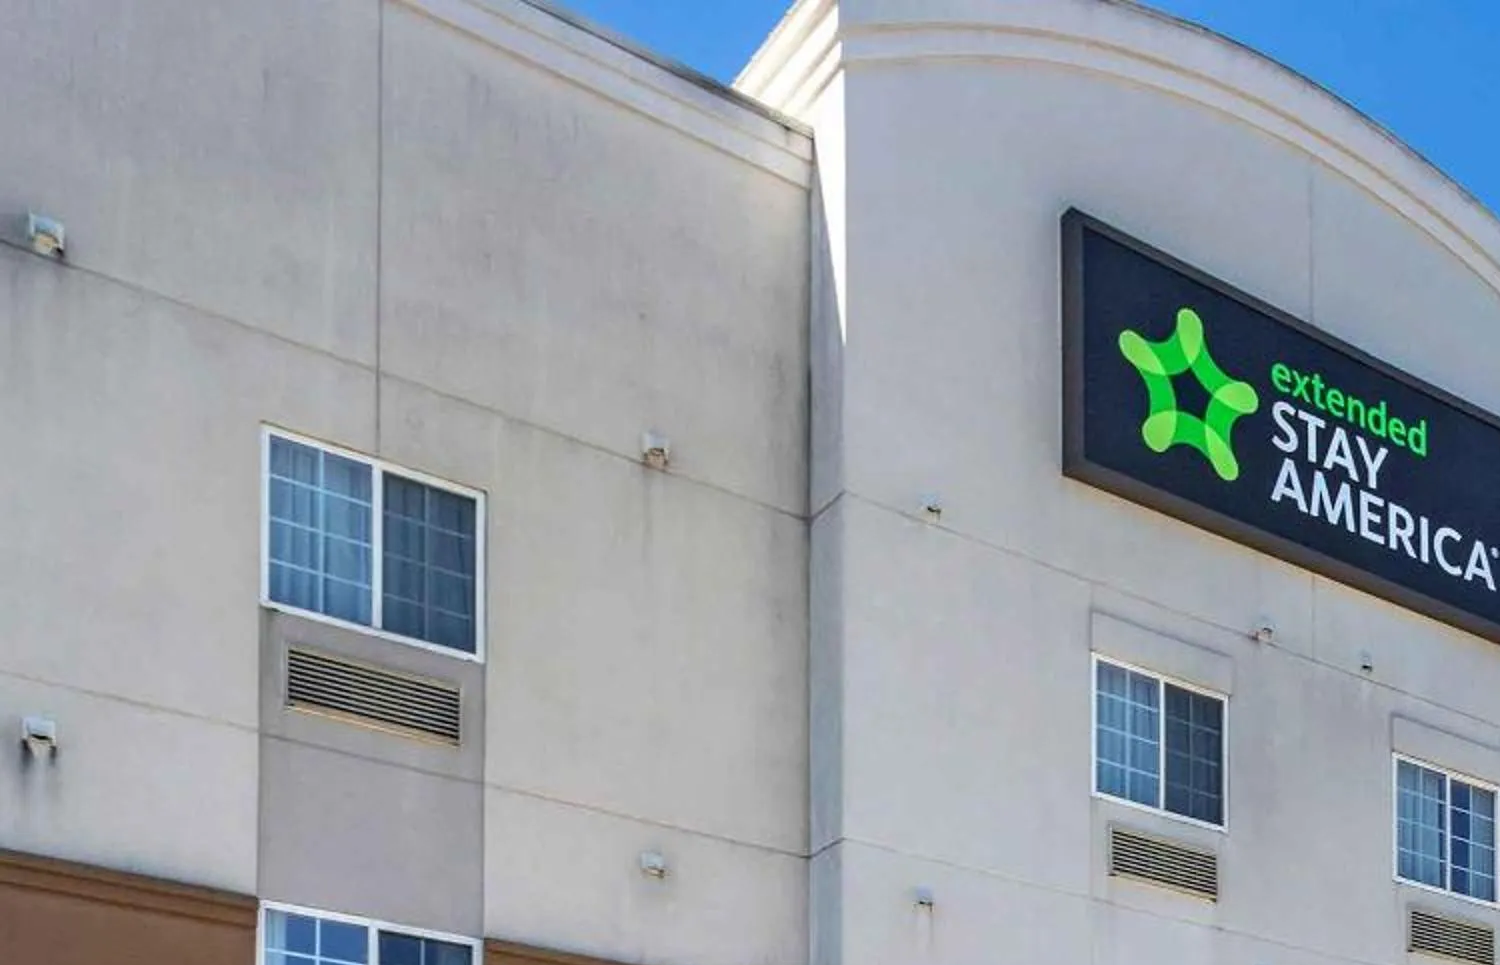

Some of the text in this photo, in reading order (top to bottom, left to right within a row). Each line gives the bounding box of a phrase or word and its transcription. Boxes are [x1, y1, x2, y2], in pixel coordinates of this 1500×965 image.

[1271, 363, 1428, 457] extended
[1271, 401, 1389, 489] STAY
[1271, 457, 1498, 592] AMERICA
